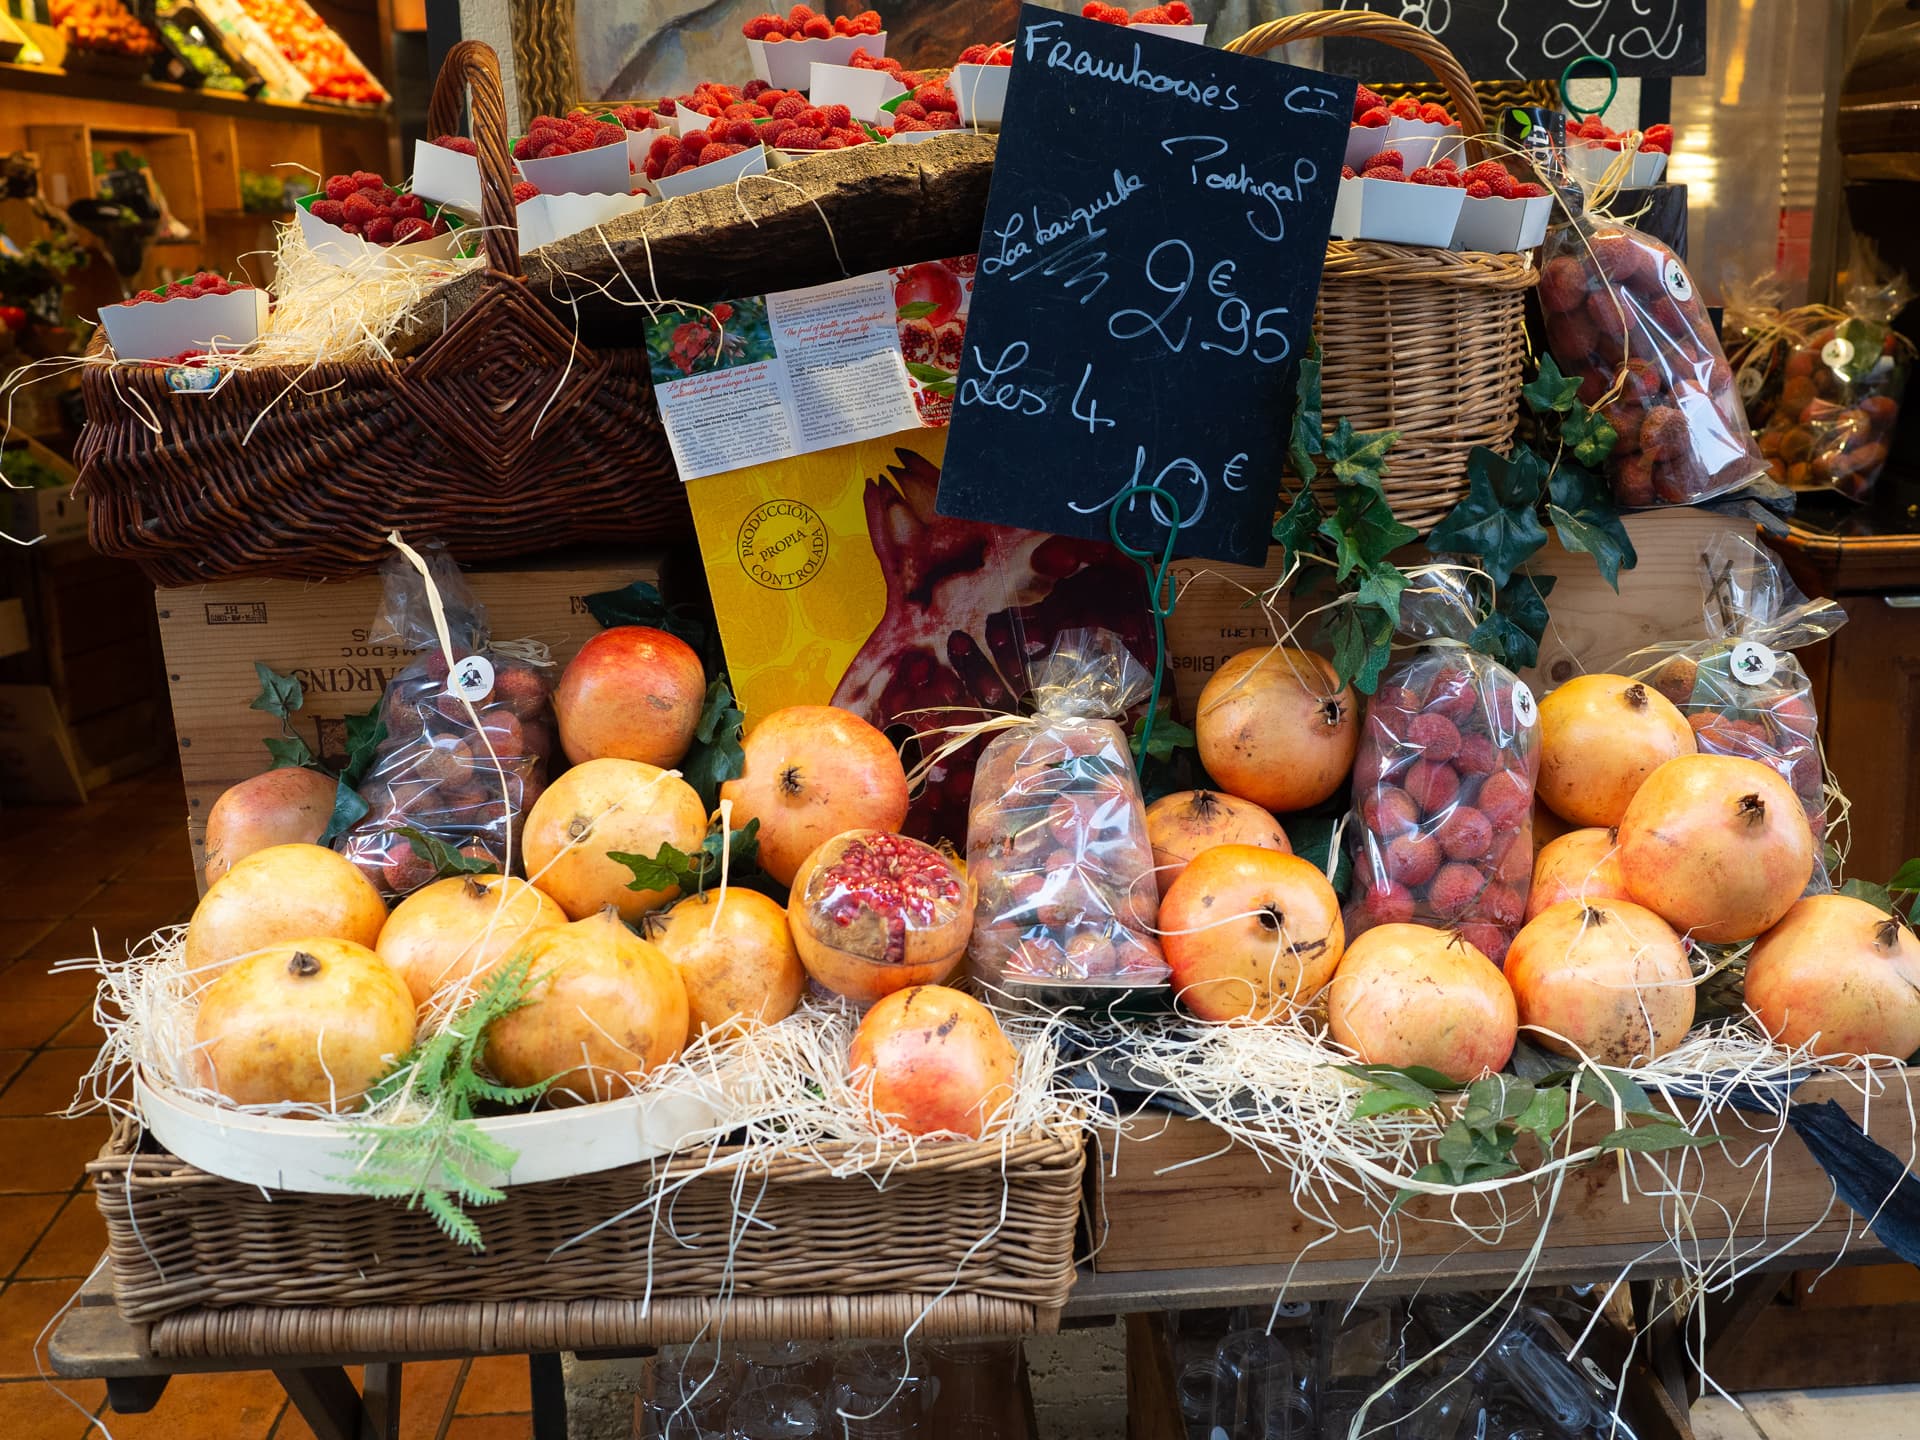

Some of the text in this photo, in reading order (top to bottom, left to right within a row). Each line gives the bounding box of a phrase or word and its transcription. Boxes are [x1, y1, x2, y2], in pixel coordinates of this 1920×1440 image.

[1161, 135, 1317, 241] Portugal
[982, 212, 1033, 275] La
[959, 341, 1047, 416] Les
[1071, 363, 1116, 434] 4
[1067, 445, 1208, 529] 10
[751, 527, 824, 585] CONTROLADA
[759, 528, 808, 562] PROPIA
[291, 663, 404, 695] ARCINS
